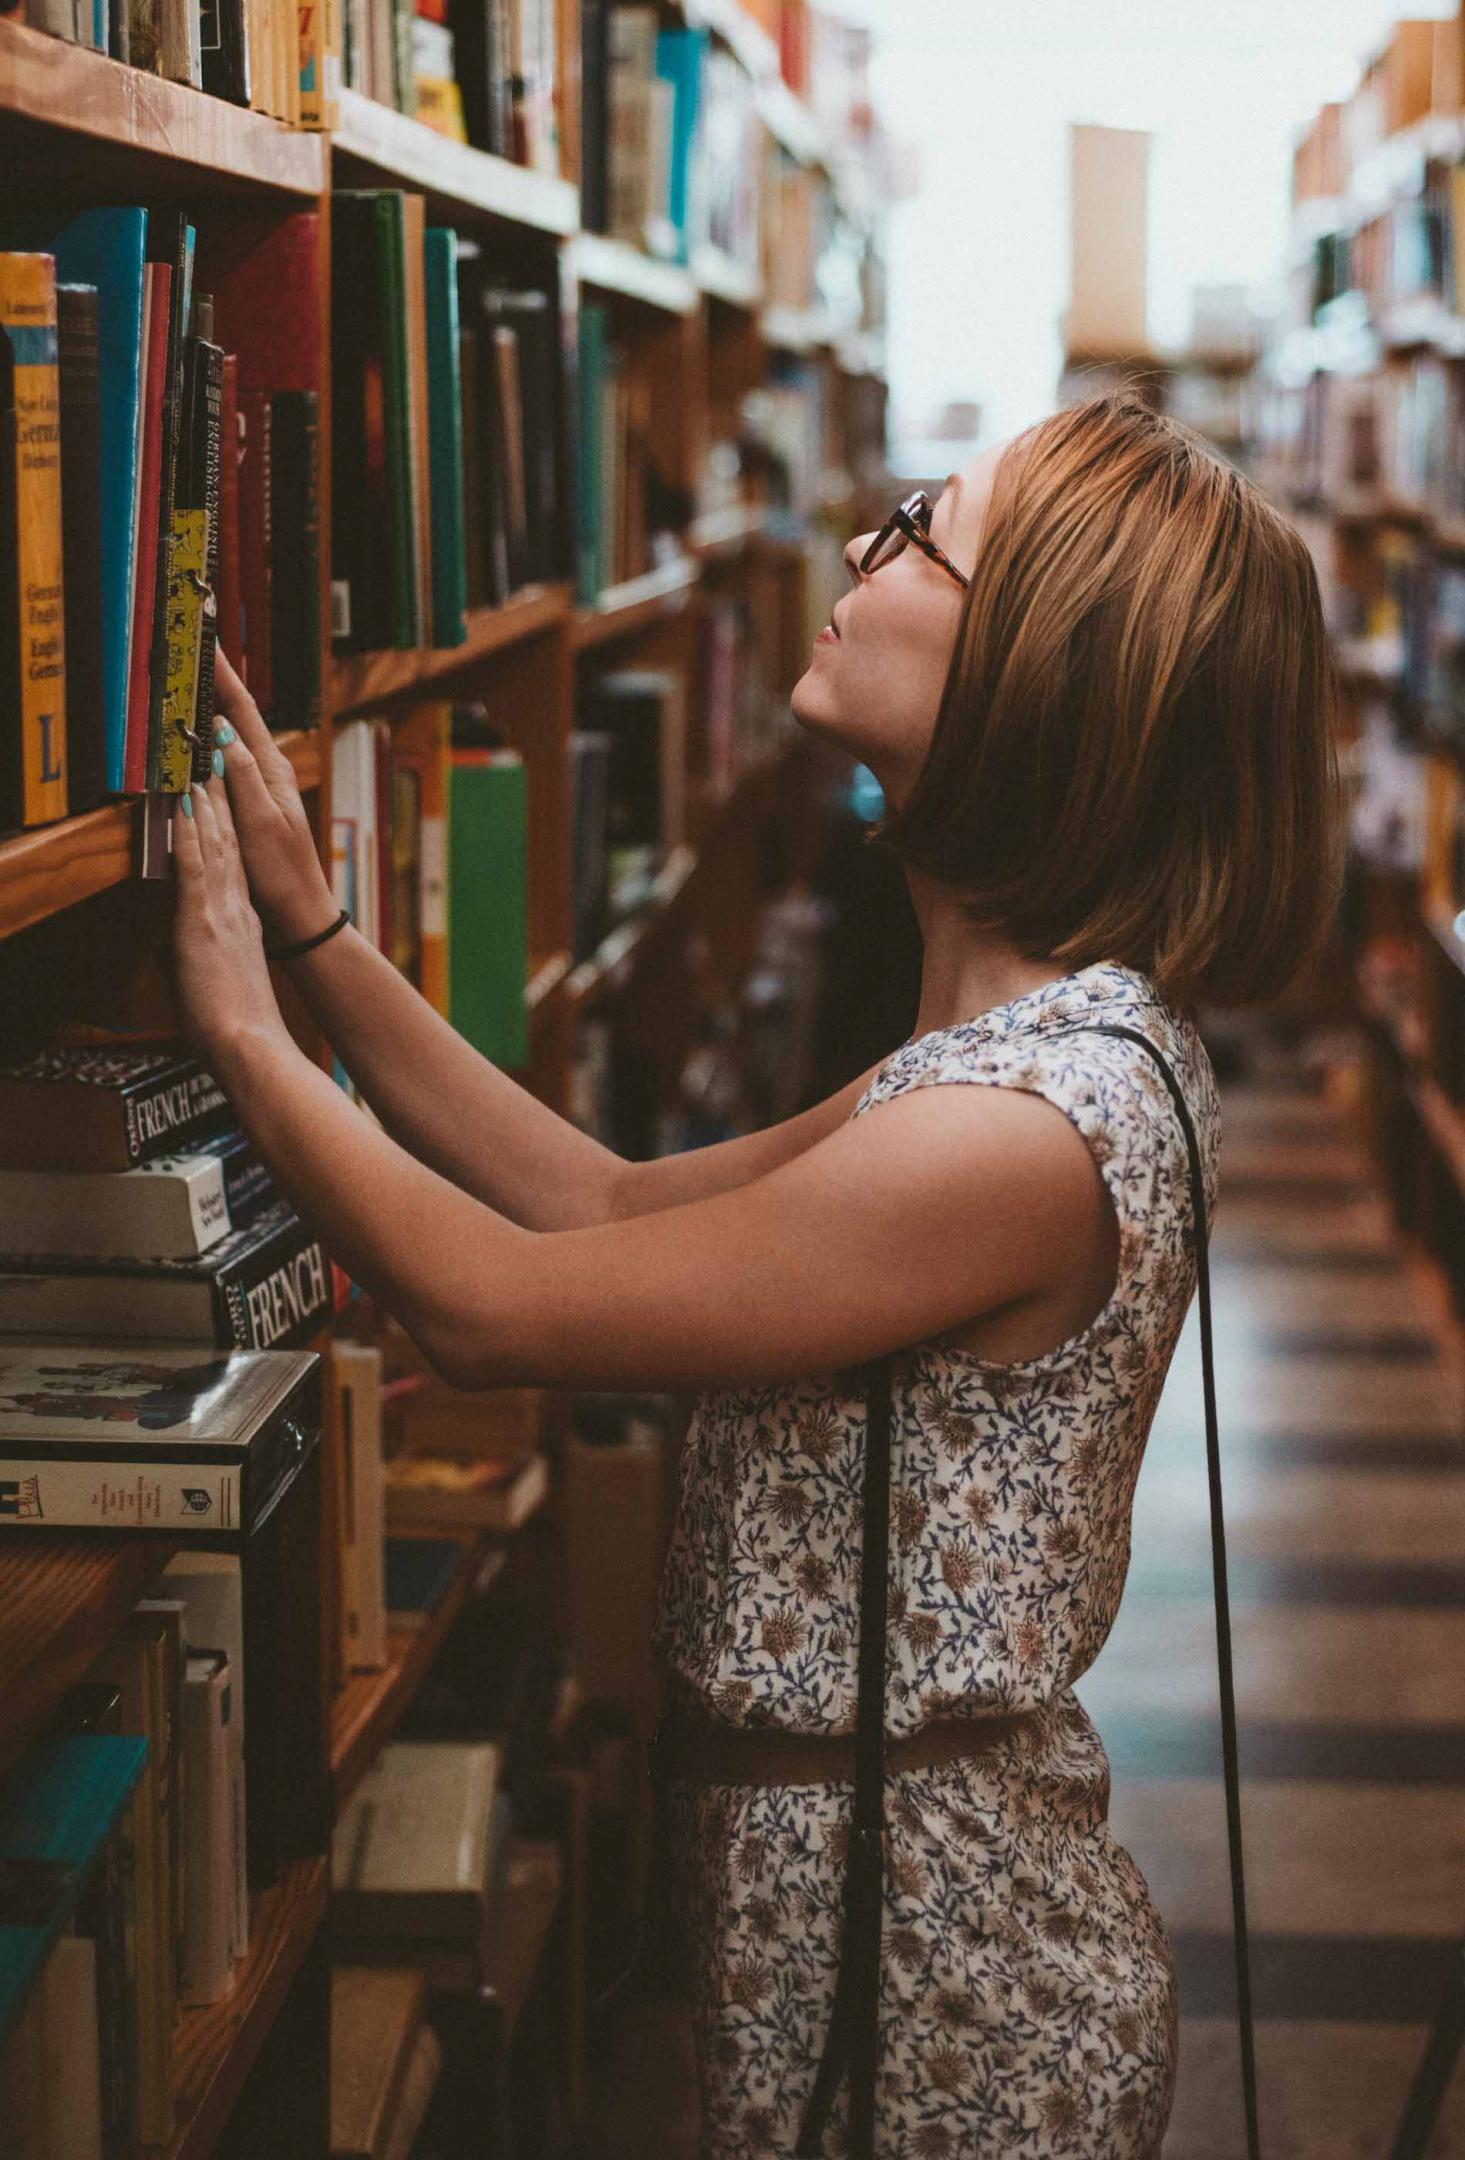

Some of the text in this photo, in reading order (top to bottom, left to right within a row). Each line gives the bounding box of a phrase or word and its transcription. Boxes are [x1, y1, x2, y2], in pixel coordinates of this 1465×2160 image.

[38, 713, 62, 785] L
[136, 1080, 192, 1143] FRENCH
[247, 1242, 327, 1351] FRENCH
